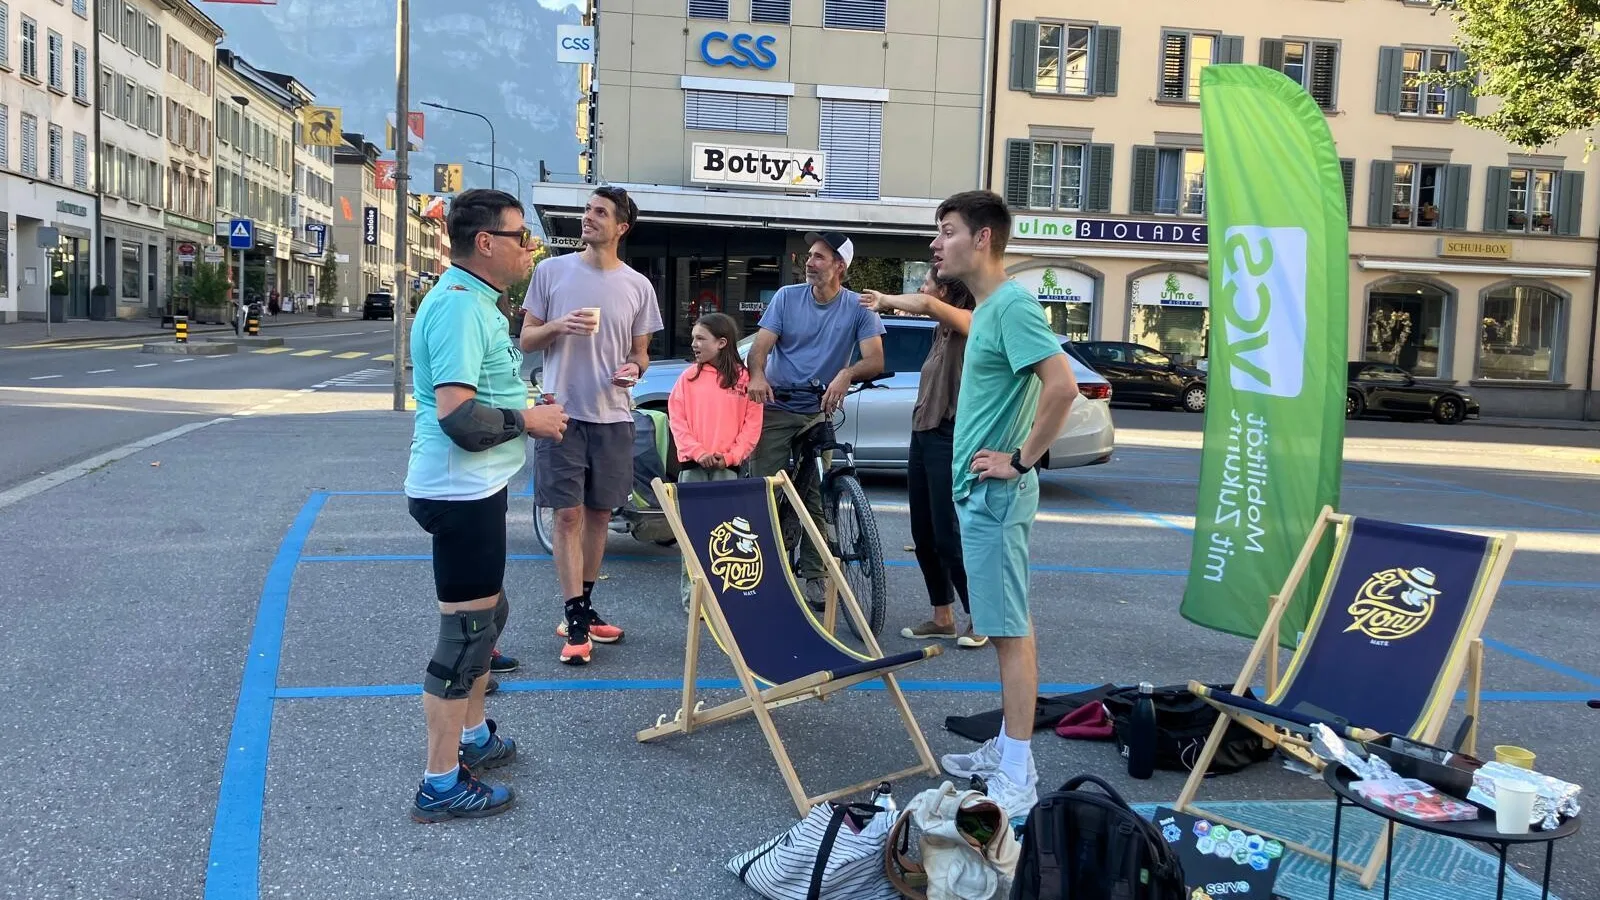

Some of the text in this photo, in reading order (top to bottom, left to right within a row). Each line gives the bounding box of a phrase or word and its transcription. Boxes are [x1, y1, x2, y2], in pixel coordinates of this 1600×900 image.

[561, 37, 590, 50] CSS
[700, 31, 777, 70] CSS
[703, 148, 791, 180] Botty
[366, 209, 375, 236] baloise
[1019, 219, 1202, 241] ulme BIOLADE
[551, 237, 579, 247] Botty
[1447, 243, 1507, 254] SCHUH-BOX
[710, 528, 734, 557] El
[711, 556, 761, 594] Tony
[1365, 572, 1403, 600] El
[1343, 599, 1430, 634] Tony
[1206, 881, 1250, 896] servo
